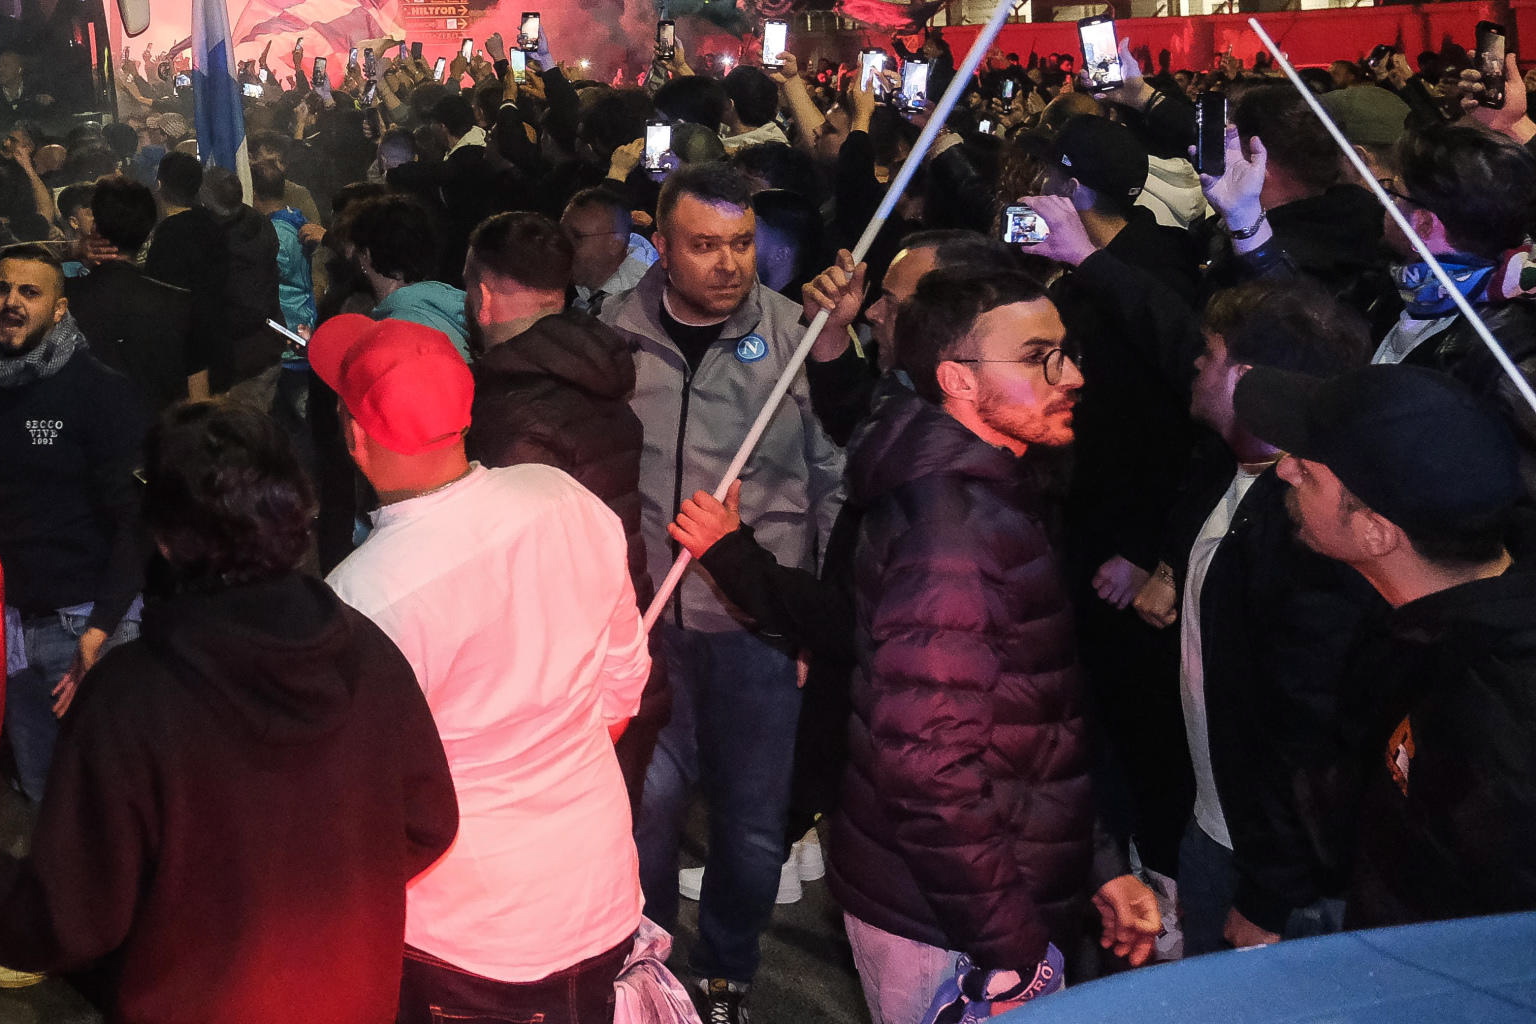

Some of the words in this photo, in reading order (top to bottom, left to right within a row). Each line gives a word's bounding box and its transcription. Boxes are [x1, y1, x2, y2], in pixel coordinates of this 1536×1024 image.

[742, 340, 760, 356] N
[25, 420, 64, 430] SECCO
[29, 429, 58, 438] VIVE
